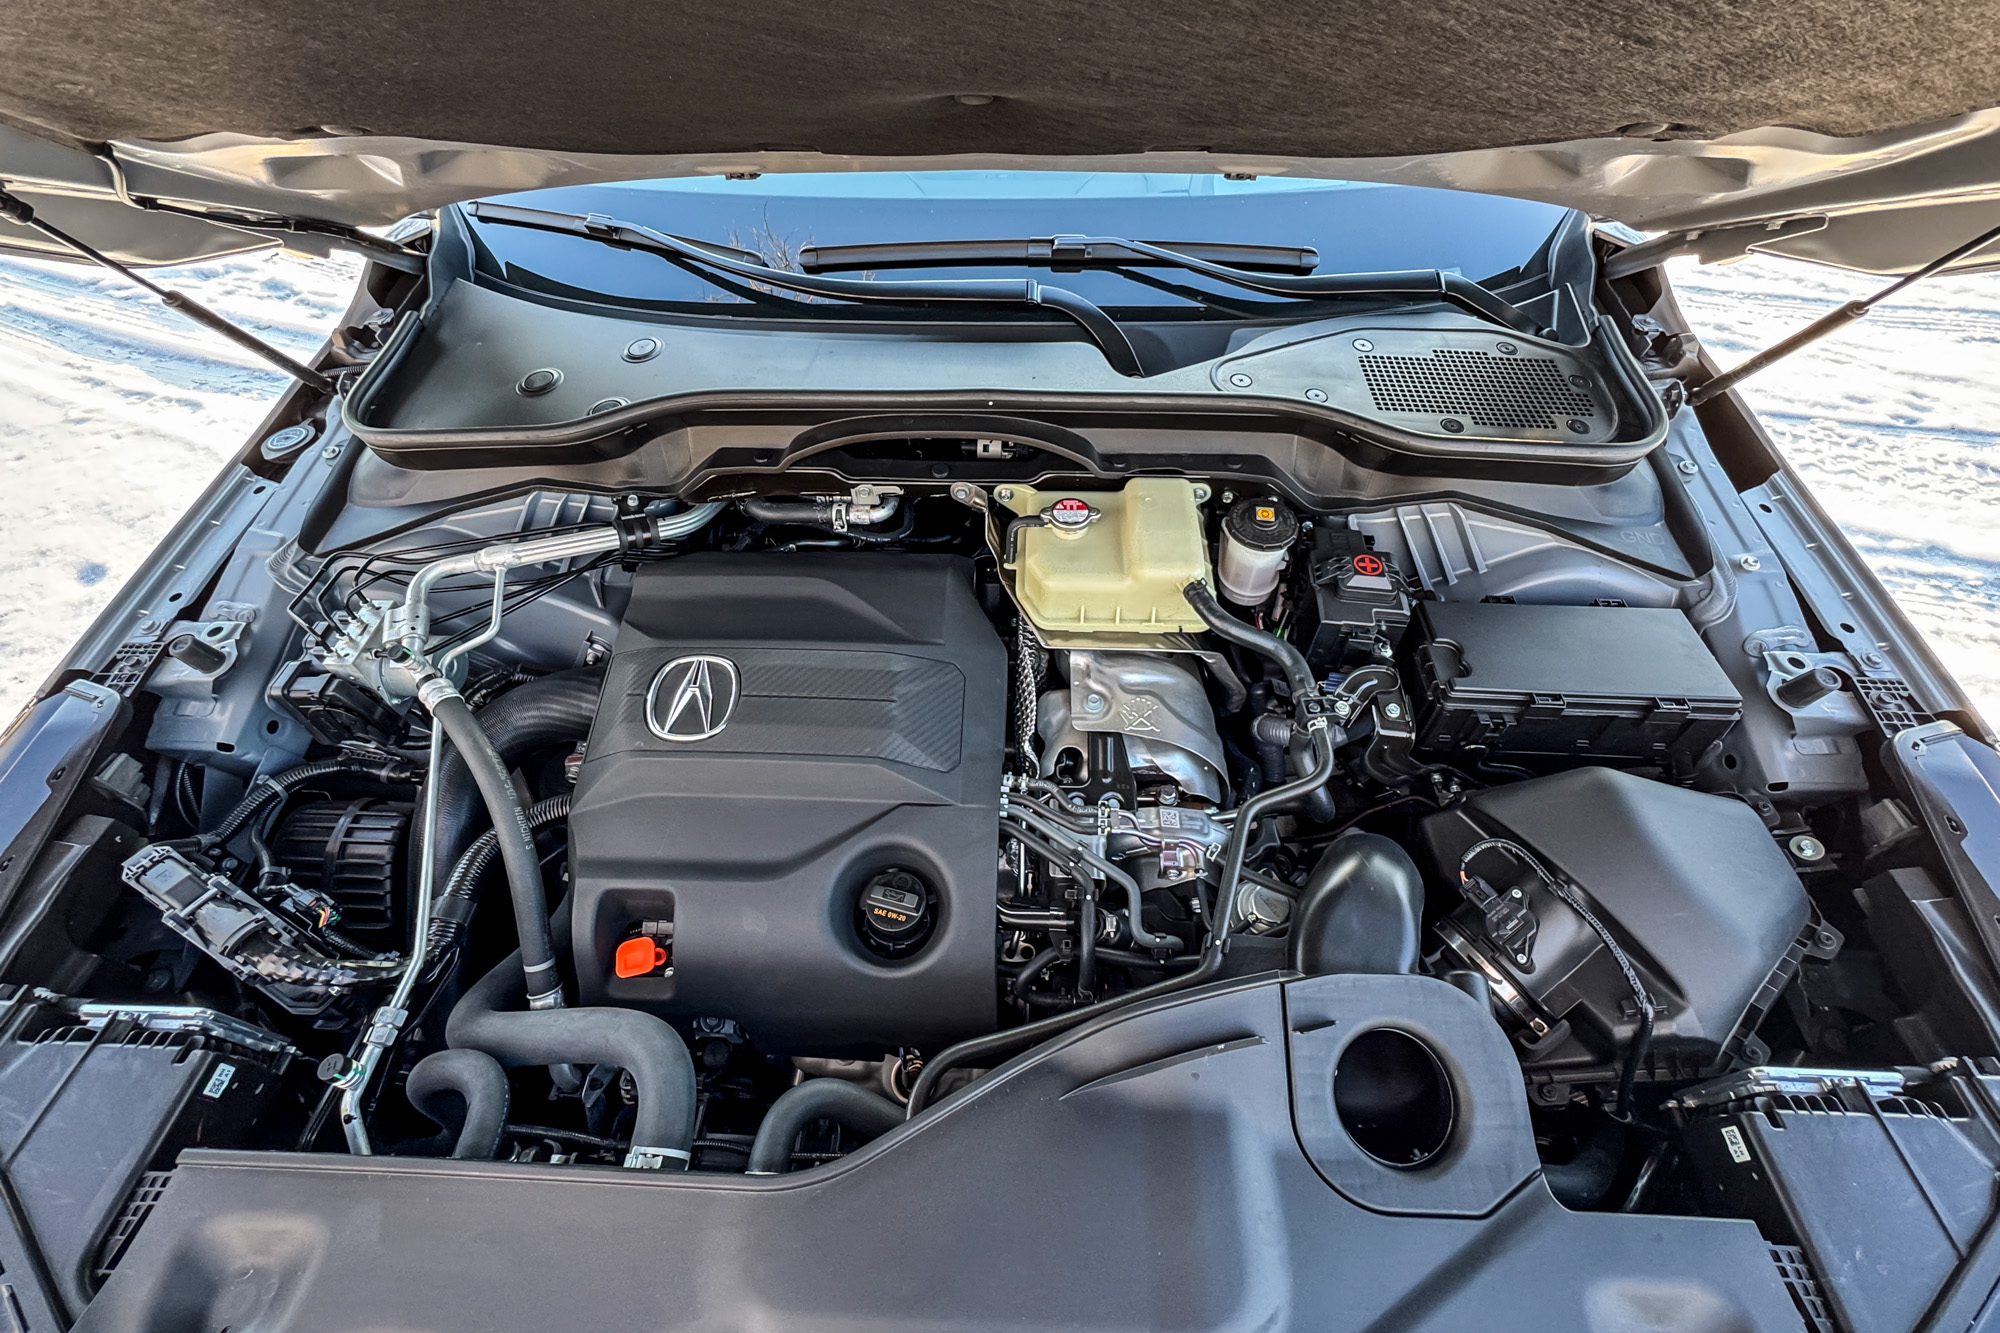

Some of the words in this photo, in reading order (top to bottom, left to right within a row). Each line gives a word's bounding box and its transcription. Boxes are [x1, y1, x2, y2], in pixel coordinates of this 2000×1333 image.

[1620, 530, 1665, 545] GND
[513, 806, 531, 842] NICHIRIN
[873, 907, 887, 917] SAE
[887, 911, 907, 922] 0W-20
